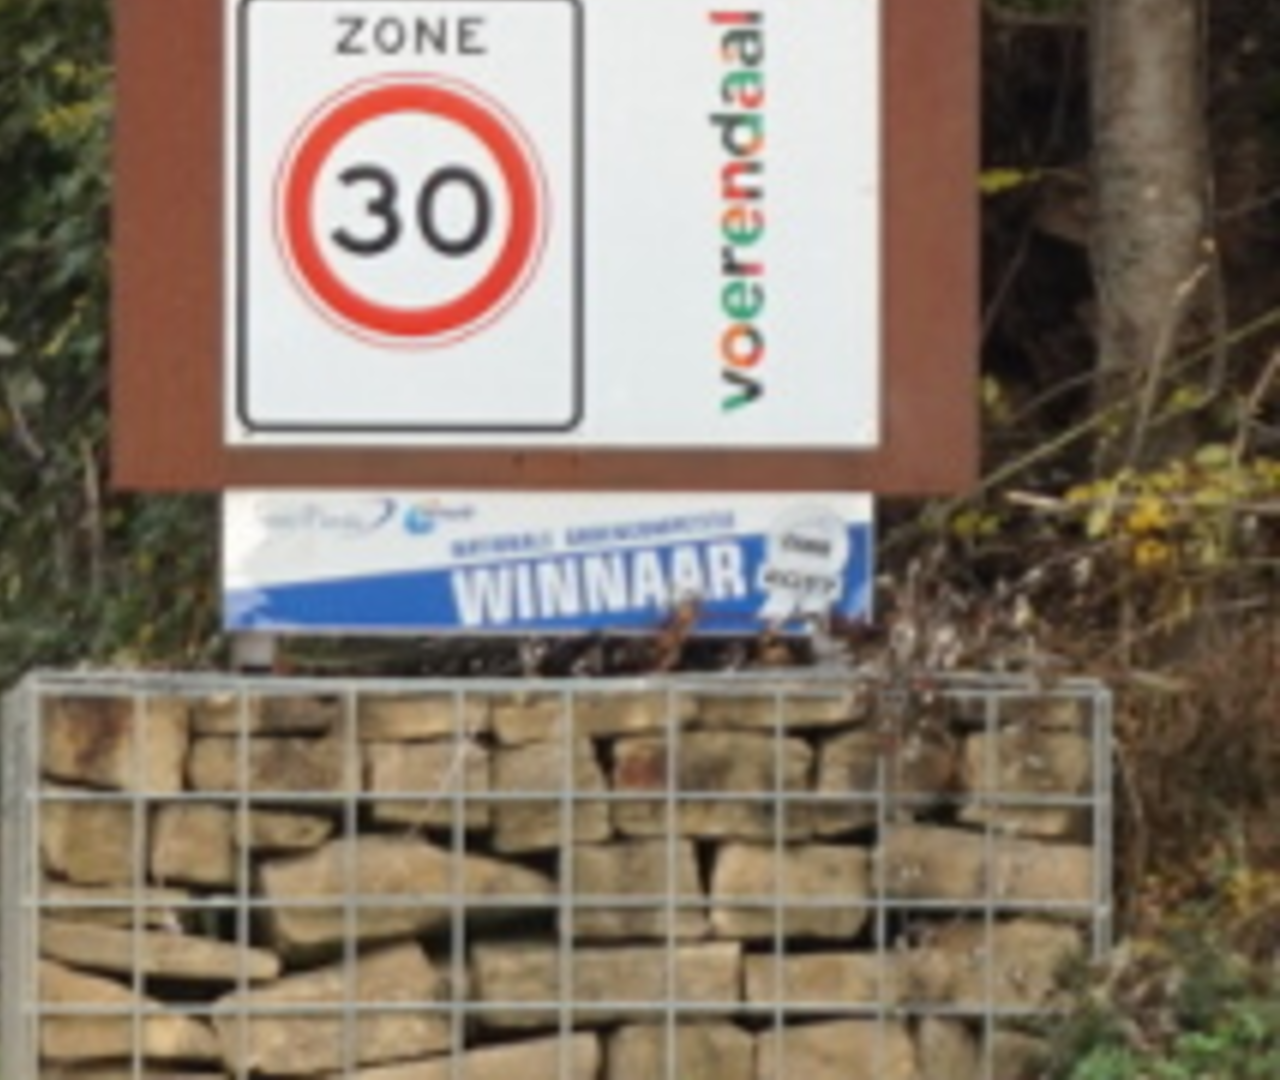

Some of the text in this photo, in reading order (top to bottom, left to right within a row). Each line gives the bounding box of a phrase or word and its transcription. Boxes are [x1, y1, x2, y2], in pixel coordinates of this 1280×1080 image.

[335, 14, 488, 56] ZONE
[329, 164, 493, 257] 30
[708, 10, 766, 414] voerendaal
[451, 540, 748, 626] WINNAAR
